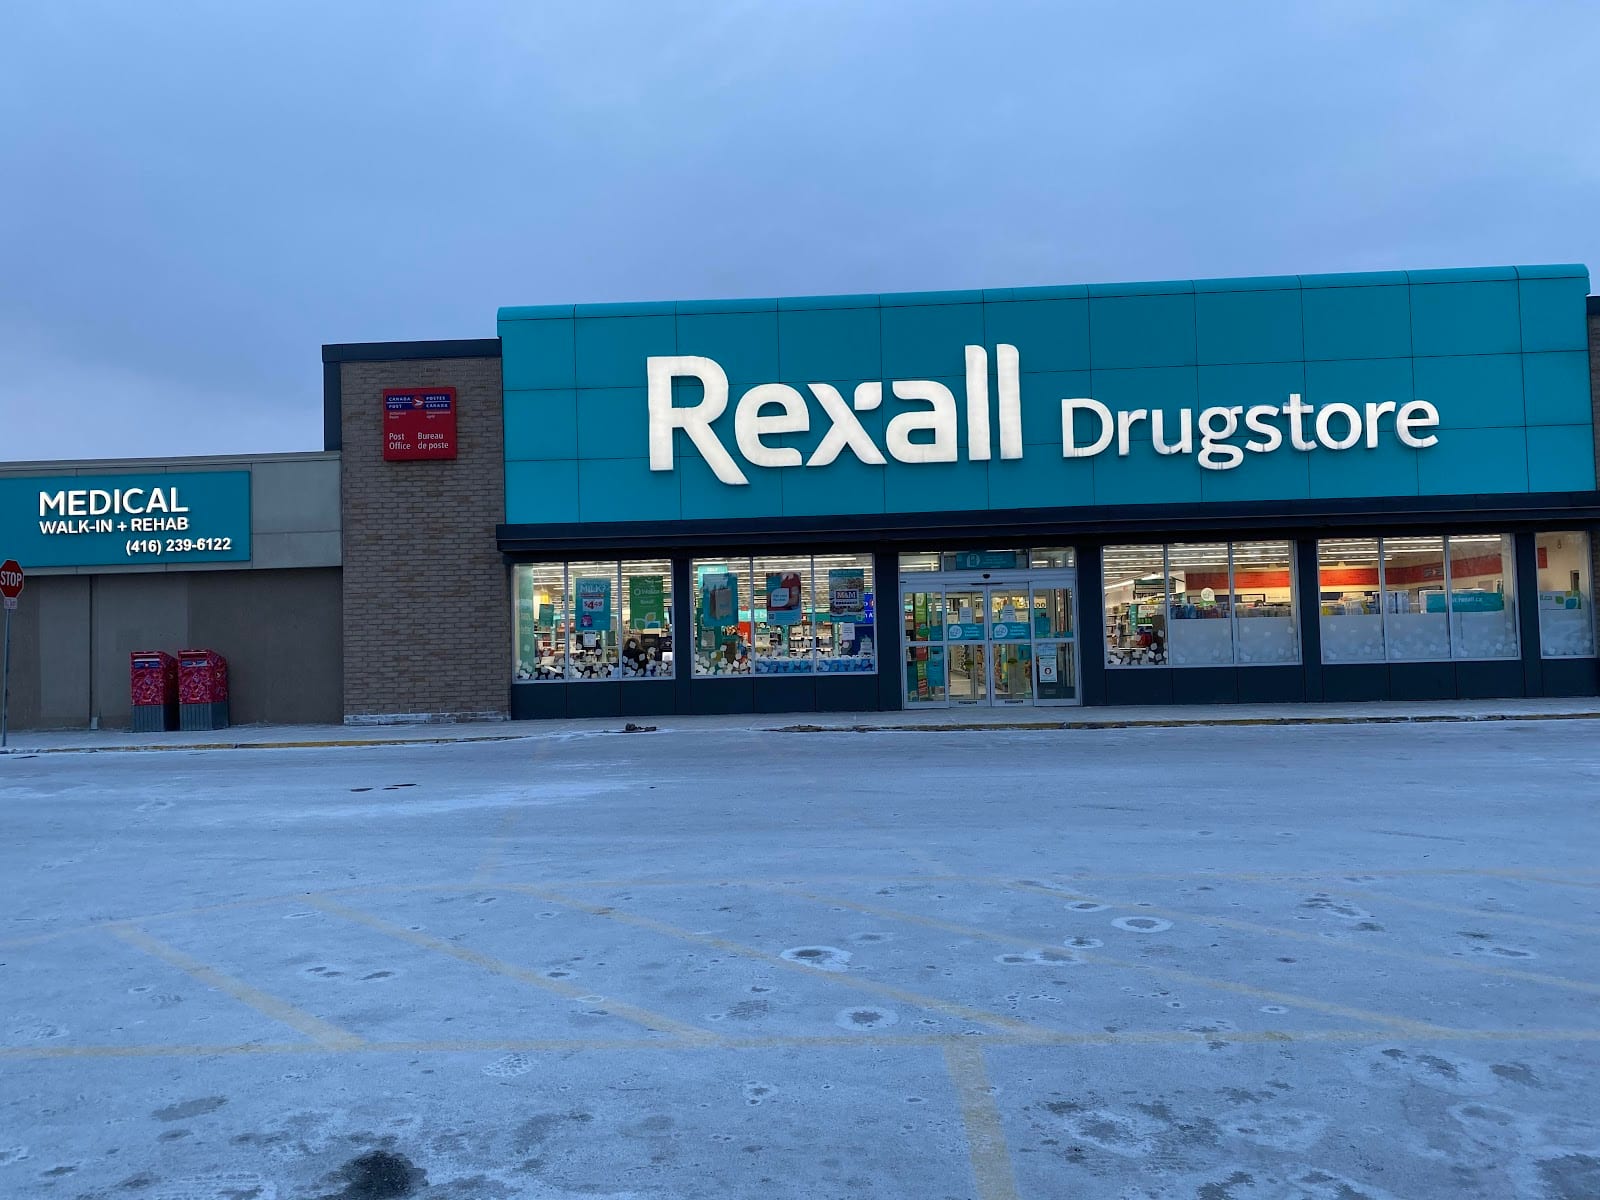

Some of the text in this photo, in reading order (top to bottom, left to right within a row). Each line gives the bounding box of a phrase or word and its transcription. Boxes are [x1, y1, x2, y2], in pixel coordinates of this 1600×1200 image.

[647, 343, 1440, 485] Rexall Drugstore
[389, 432, 405, 441] Post
[418, 432, 443, 440] Bureau
[389, 441, 411, 450] Office
[417, 441, 449, 451] de poste
[39, 487, 190, 516] MEDICAL
[39, 516, 190, 534] WALK-IN + REHAB
[126, 537, 232, 556] (416) 239-6122
[1, 571, 22, 587] STOP
